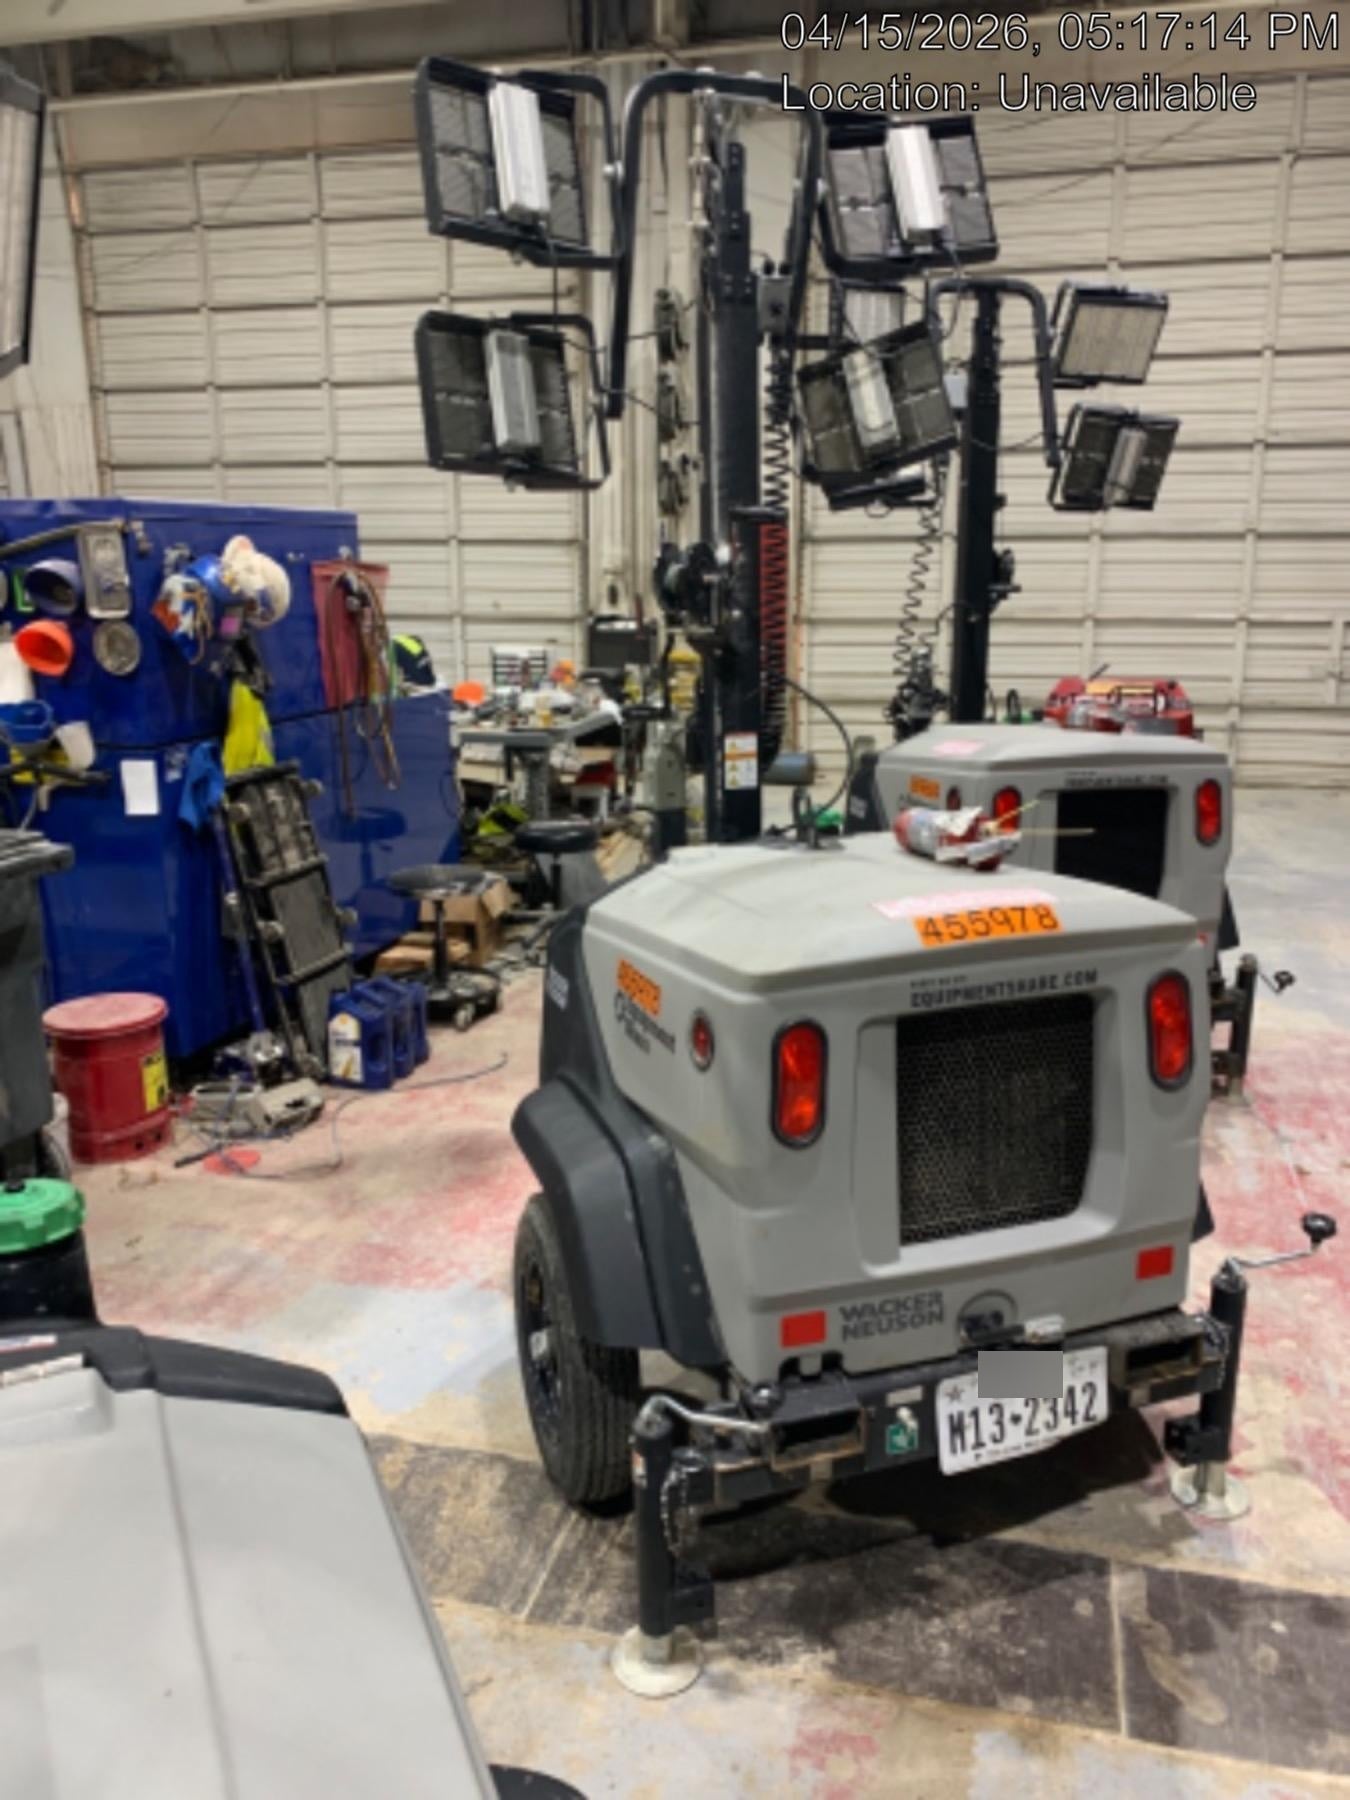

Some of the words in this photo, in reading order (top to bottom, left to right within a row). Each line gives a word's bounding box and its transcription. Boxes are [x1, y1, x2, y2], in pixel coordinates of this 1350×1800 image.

[921, 904, 1059, 943] 455978
[838, 1289, 944, 1323] WACKER
[841, 1309, 944, 1342] NEUSON
